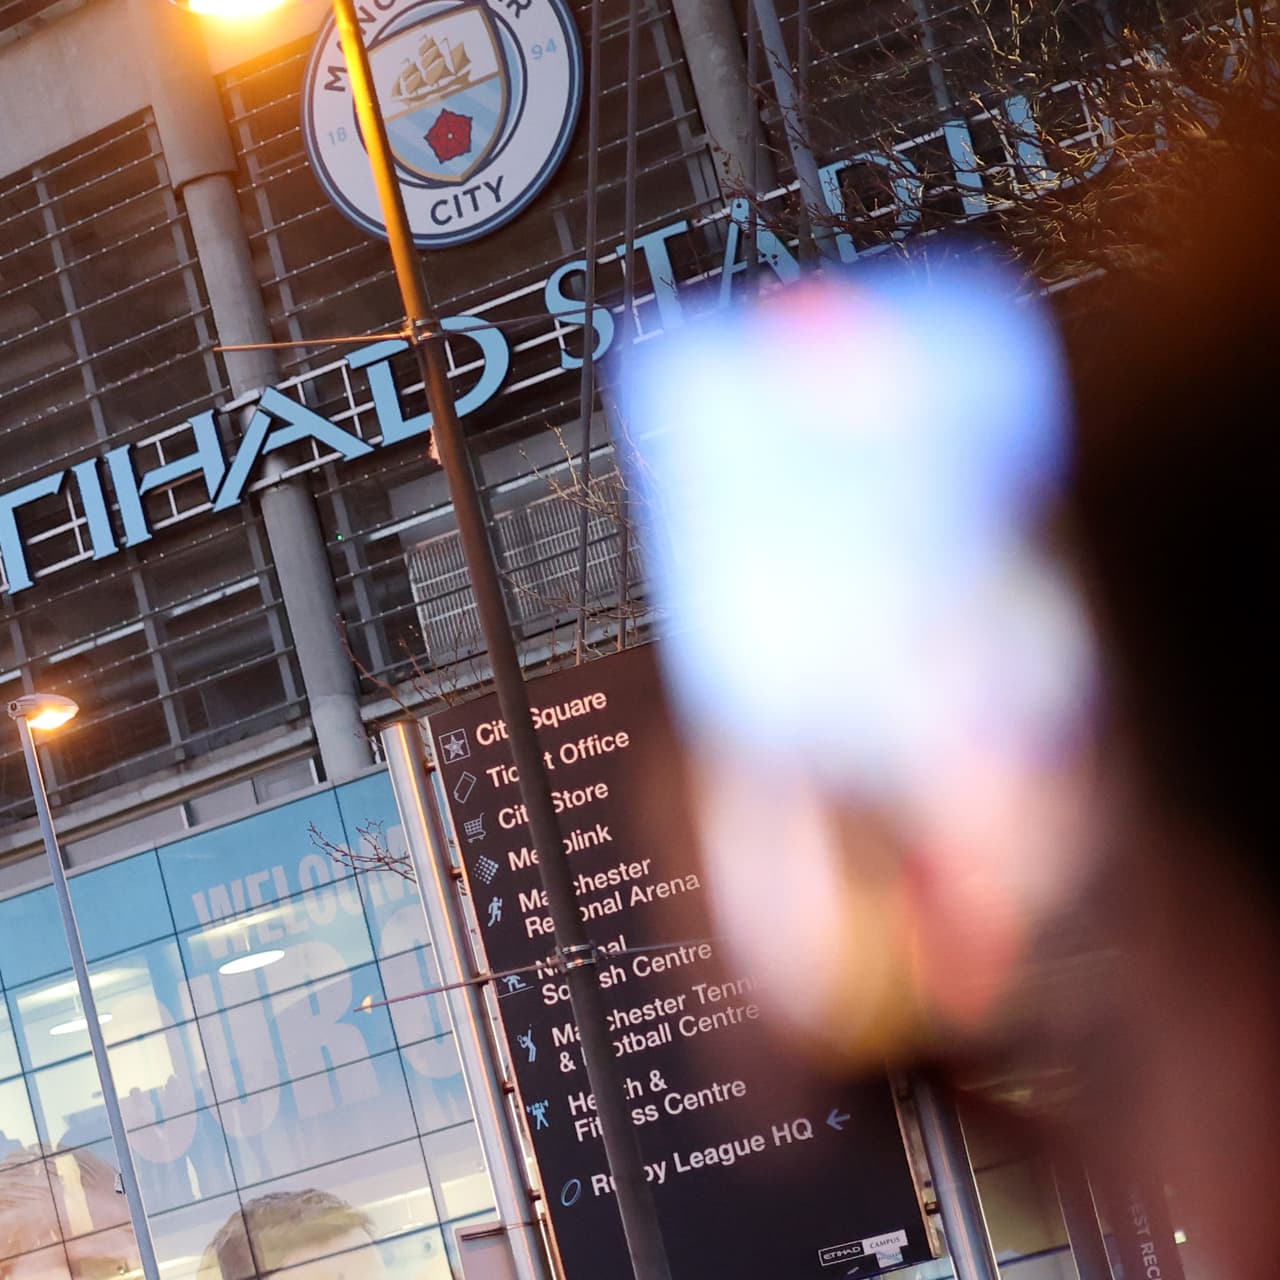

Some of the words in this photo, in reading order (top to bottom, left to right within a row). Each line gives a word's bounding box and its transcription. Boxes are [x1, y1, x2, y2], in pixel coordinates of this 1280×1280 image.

[430, 176, 505, 226] CITY
[476, 718, 514, 746] Cit
[486, 751, 555, 788] Tict
[559, 731, 630, 765] Office
[498, 804, 534, 829] Cit
[630, 873, 700, 907] Arena
[632, 942, 713, 978] Centre
[559, 1052, 576, 1073] &
[679, 1003, 760, 1038] Centre
[649, 1070, 668, 1092] &
[663, 1079, 747, 1116] Centre
[672, 1133, 766, 1174] League
[771, 1117, 815, 1146] HQ
[823, 1246, 861, 1260] ETIHAD
